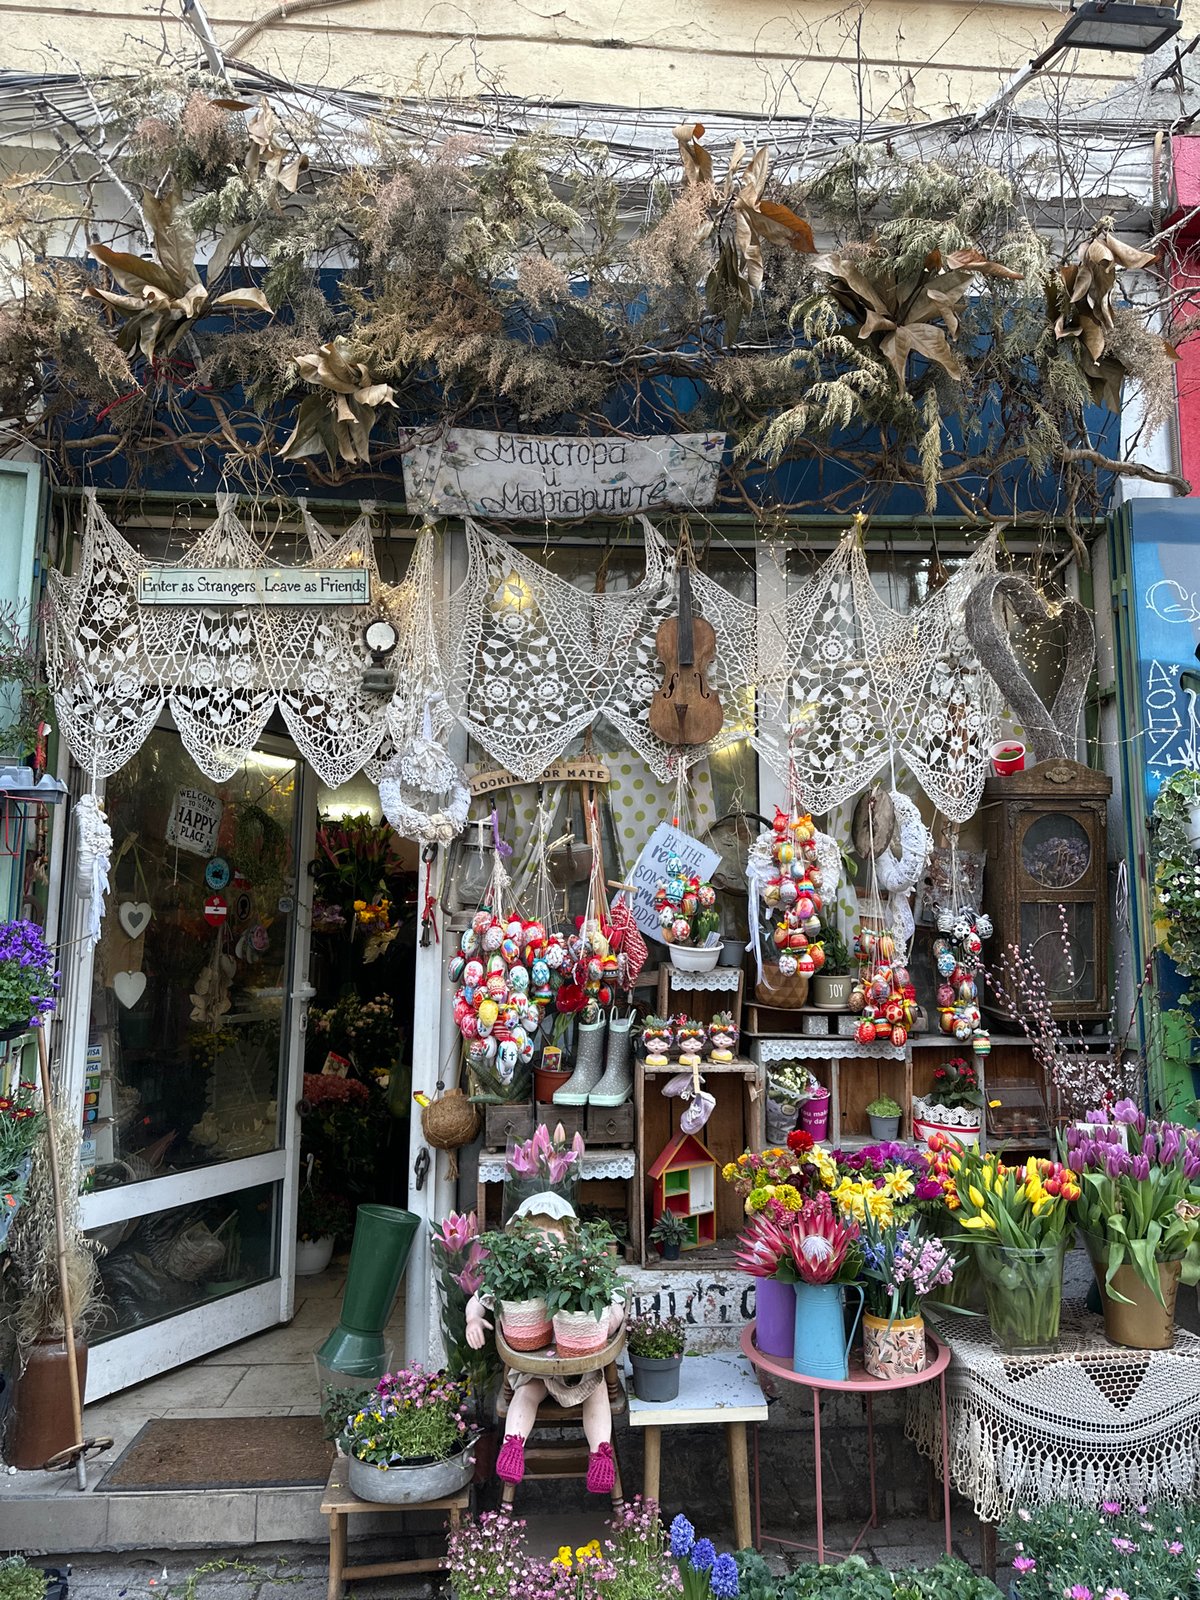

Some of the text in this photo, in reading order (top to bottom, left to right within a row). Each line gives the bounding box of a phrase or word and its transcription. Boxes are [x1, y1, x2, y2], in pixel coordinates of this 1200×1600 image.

[480, 478, 668, 518] Маргаритите
[142, 577, 179, 592] Enter
[181, 579, 194, 592] as
[197, 577, 255, 597] Strangers
[304, 579, 317, 592] as
[320, 577, 366, 593] Friends
[472, 774, 523, 792] LOOKIN
[543, 769, 605, 778] OR MATE
[180, 790, 216, 809] WELCOME
[198, 803, 209, 812] OUR
[174, 806, 217, 835] HAPPY
[180, 826, 205, 843] PLACE
[662, 834, 706, 868] BE THE
[632, 902, 661, 930] ODAY
[829, 984, 844, 999] JOY
